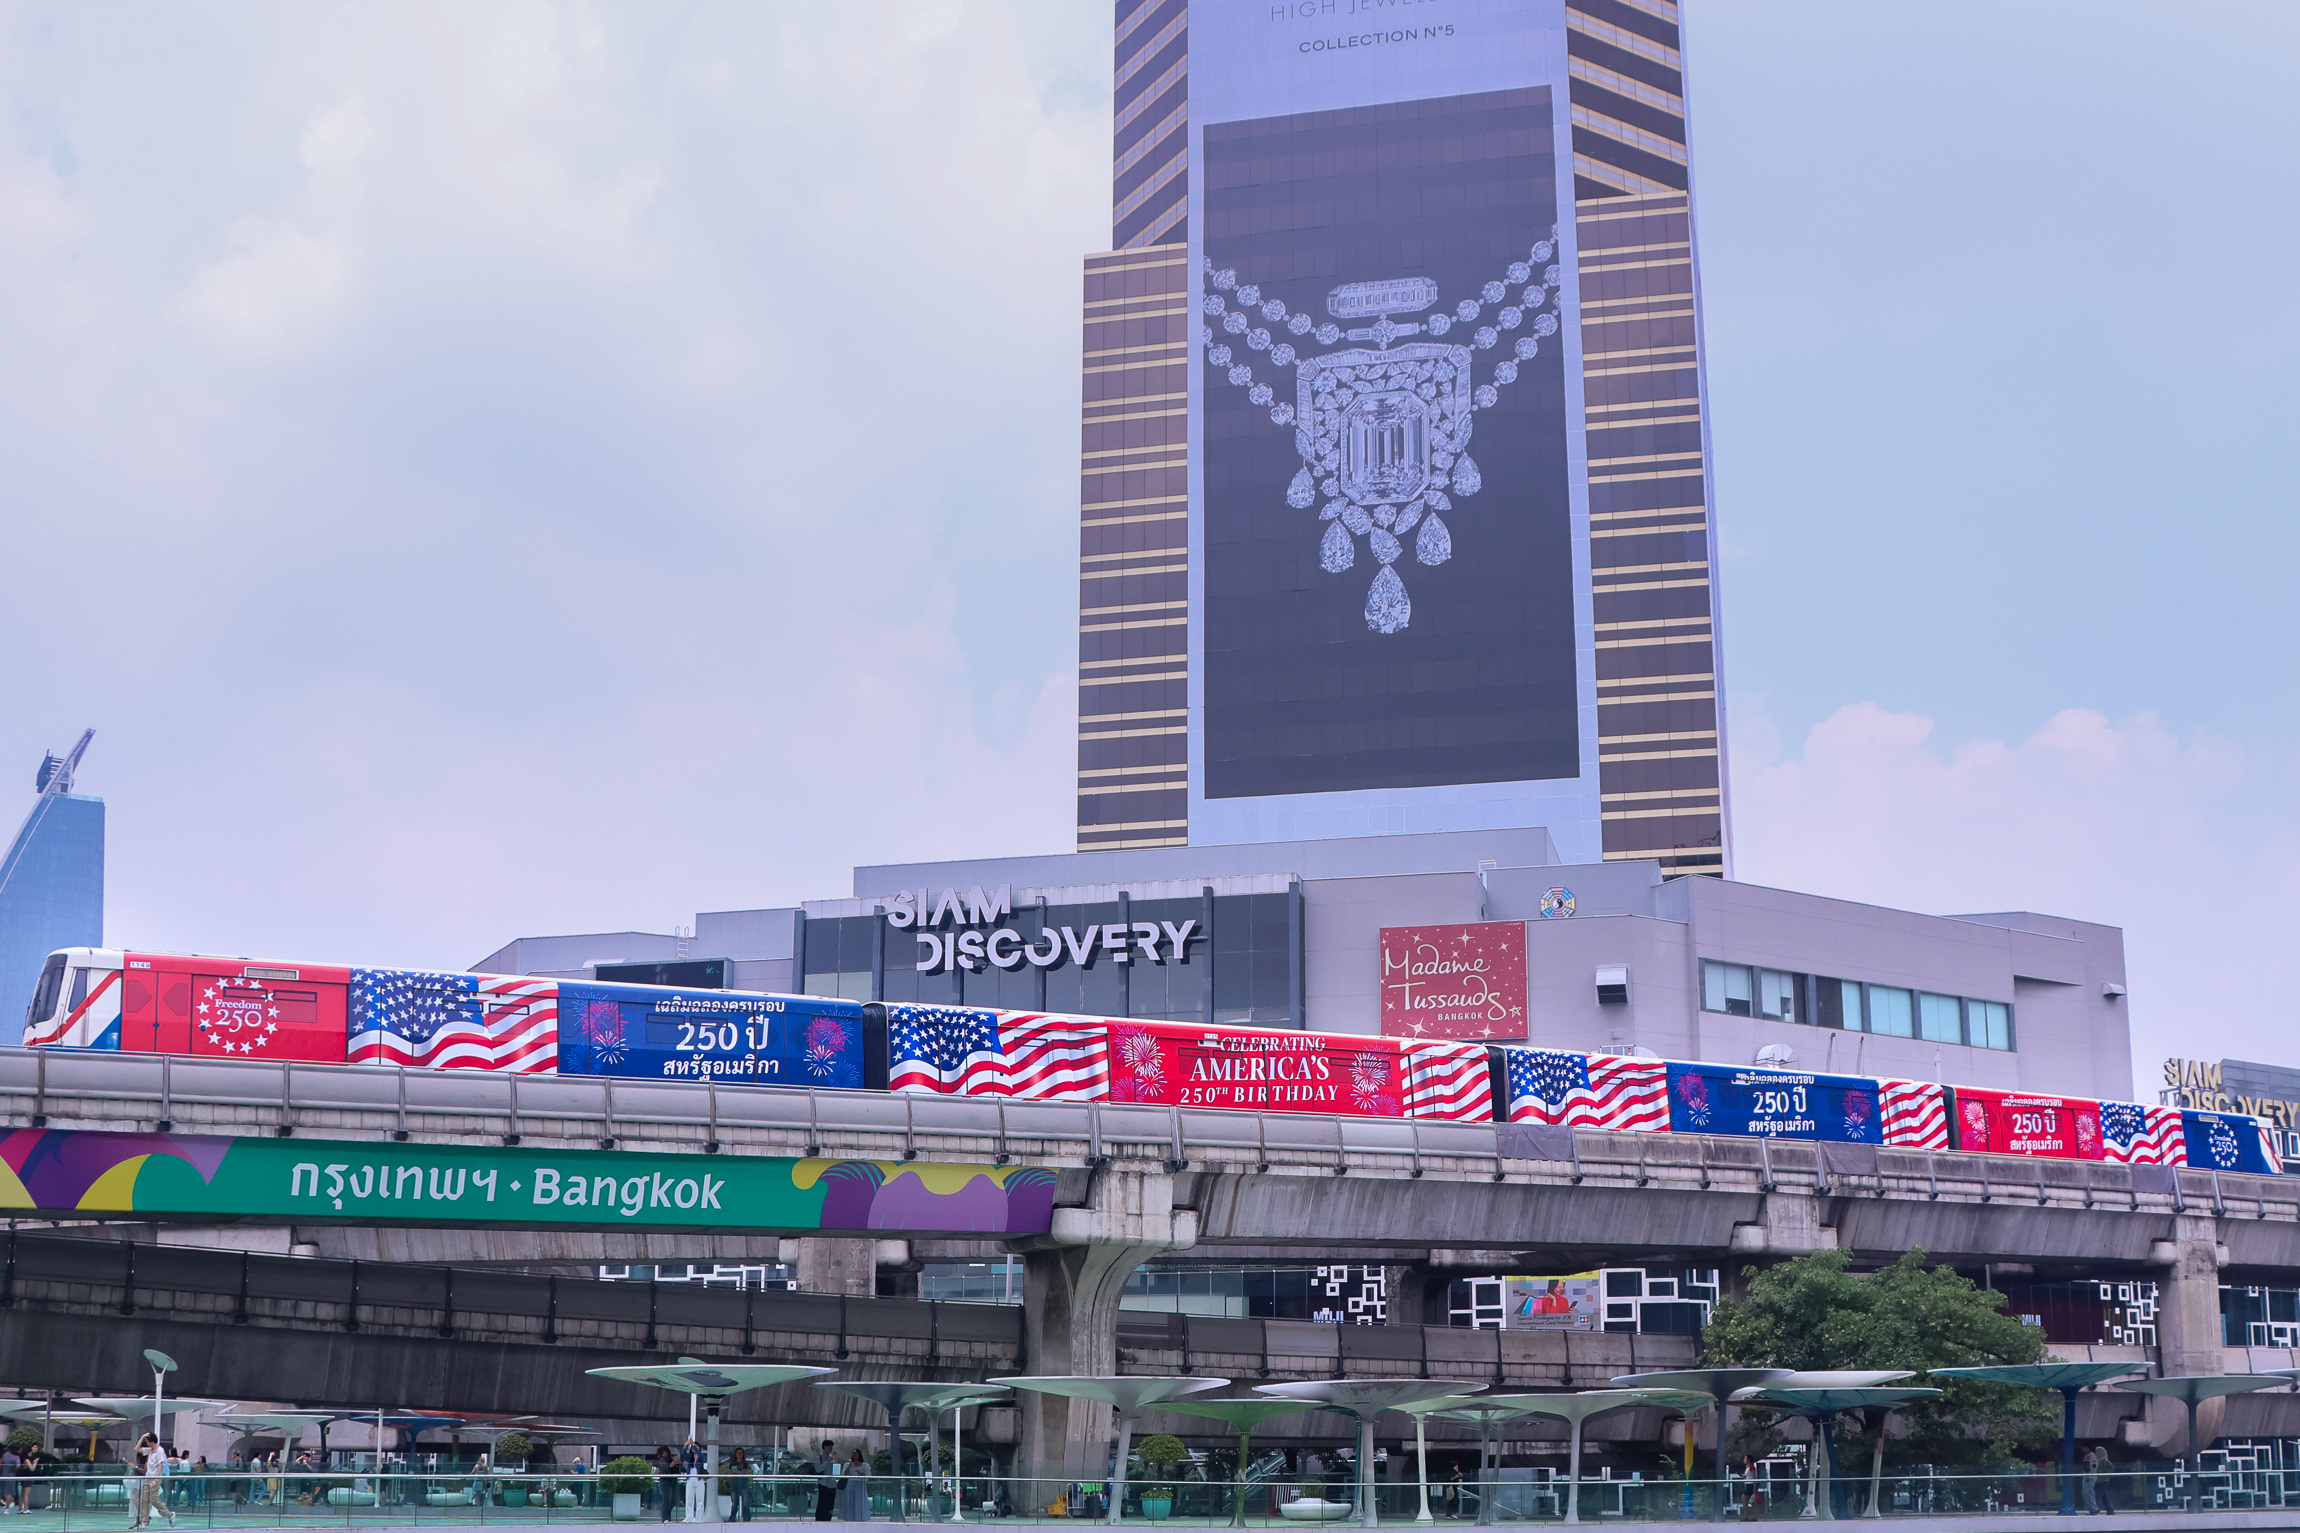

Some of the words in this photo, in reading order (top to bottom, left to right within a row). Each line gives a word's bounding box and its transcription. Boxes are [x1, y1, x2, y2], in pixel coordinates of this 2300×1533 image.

[1271, 0, 1335, 21] HIGH
[1299, 29, 1418, 53] COLLECTION
[1424, 24, 1455, 38] N°5
[887, 883, 1011, 927] SIAM
[916, 920, 1196, 971] DISCOVERY
[1385, 944, 1490, 980] Madame
[215, 999, 262, 1010] Freedom
[655, 995, 785, 1012] เฉลิมฉลองครบรอบ
[1388, 975, 1507, 1021] Tussauds
[215, 1009, 262, 1033] 250
[1438, 1012, 1483, 1021] BANGKOK
[676, 1022, 738, 1050] 250
[745, 1014, 770, 1049] ปี
[1220, 1037, 1326, 1051] CELEBRATING
[663, 1053, 779, 1081] สหรัฐอเมริกา
[1189, 1055, 1330, 1081] AMERICA'S
[2164, 1058, 2222, 1091] SIAM
[1180, 1087, 1228, 1103] 250TH
[1234, 1085, 1338, 1102] BIRTHDAY
[1753, 1091, 1789, 1113] 250
[1793, 1085, 1806, 1112] ปี
[2012, 1113, 2042, 1134] 250
[2044, 1108, 2056, 1133] ปี
[2180, 1089, 2299, 1127] DISCOVERY
[1748, 1115, 1815, 1136] สหรัฐอเมริกา
[2216, 1141, 2233, 1155] 250
[291, 1162, 497, 1210] กรุงเทพฯ
[532, 1168, 726, 1217] Bangkok
